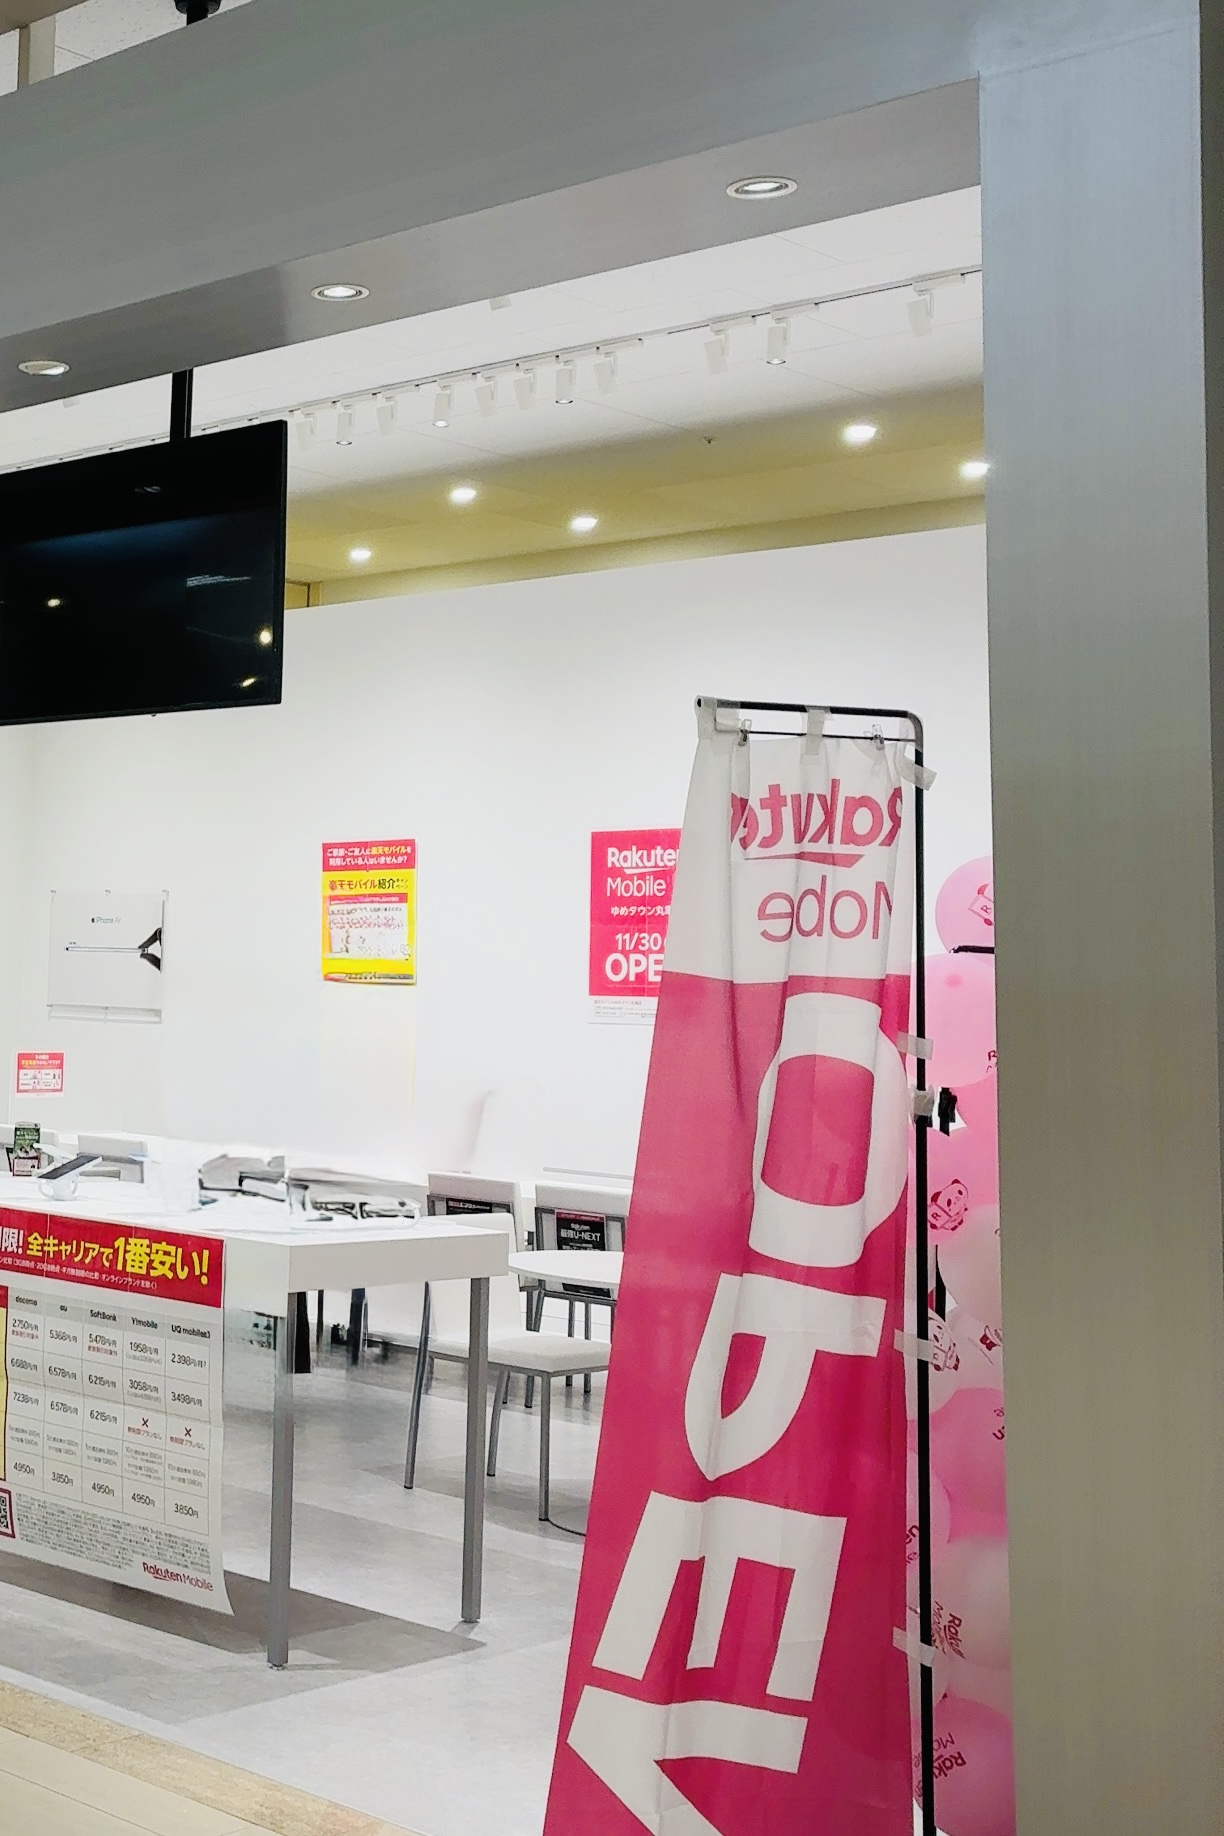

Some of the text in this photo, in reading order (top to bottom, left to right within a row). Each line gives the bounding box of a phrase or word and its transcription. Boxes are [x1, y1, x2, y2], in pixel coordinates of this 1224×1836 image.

[607, 845, 680, 869] Rakute
[606, 875, 667, 898] Mobile
[27, 1231, 210, 1286] 全キャリアで1番安い!
[89, 1309, 118, 1322] SoftBank
[171, 1324, 182, 1334] UQ
[142, 1561, 214, 1592] Rakuten Mobile
